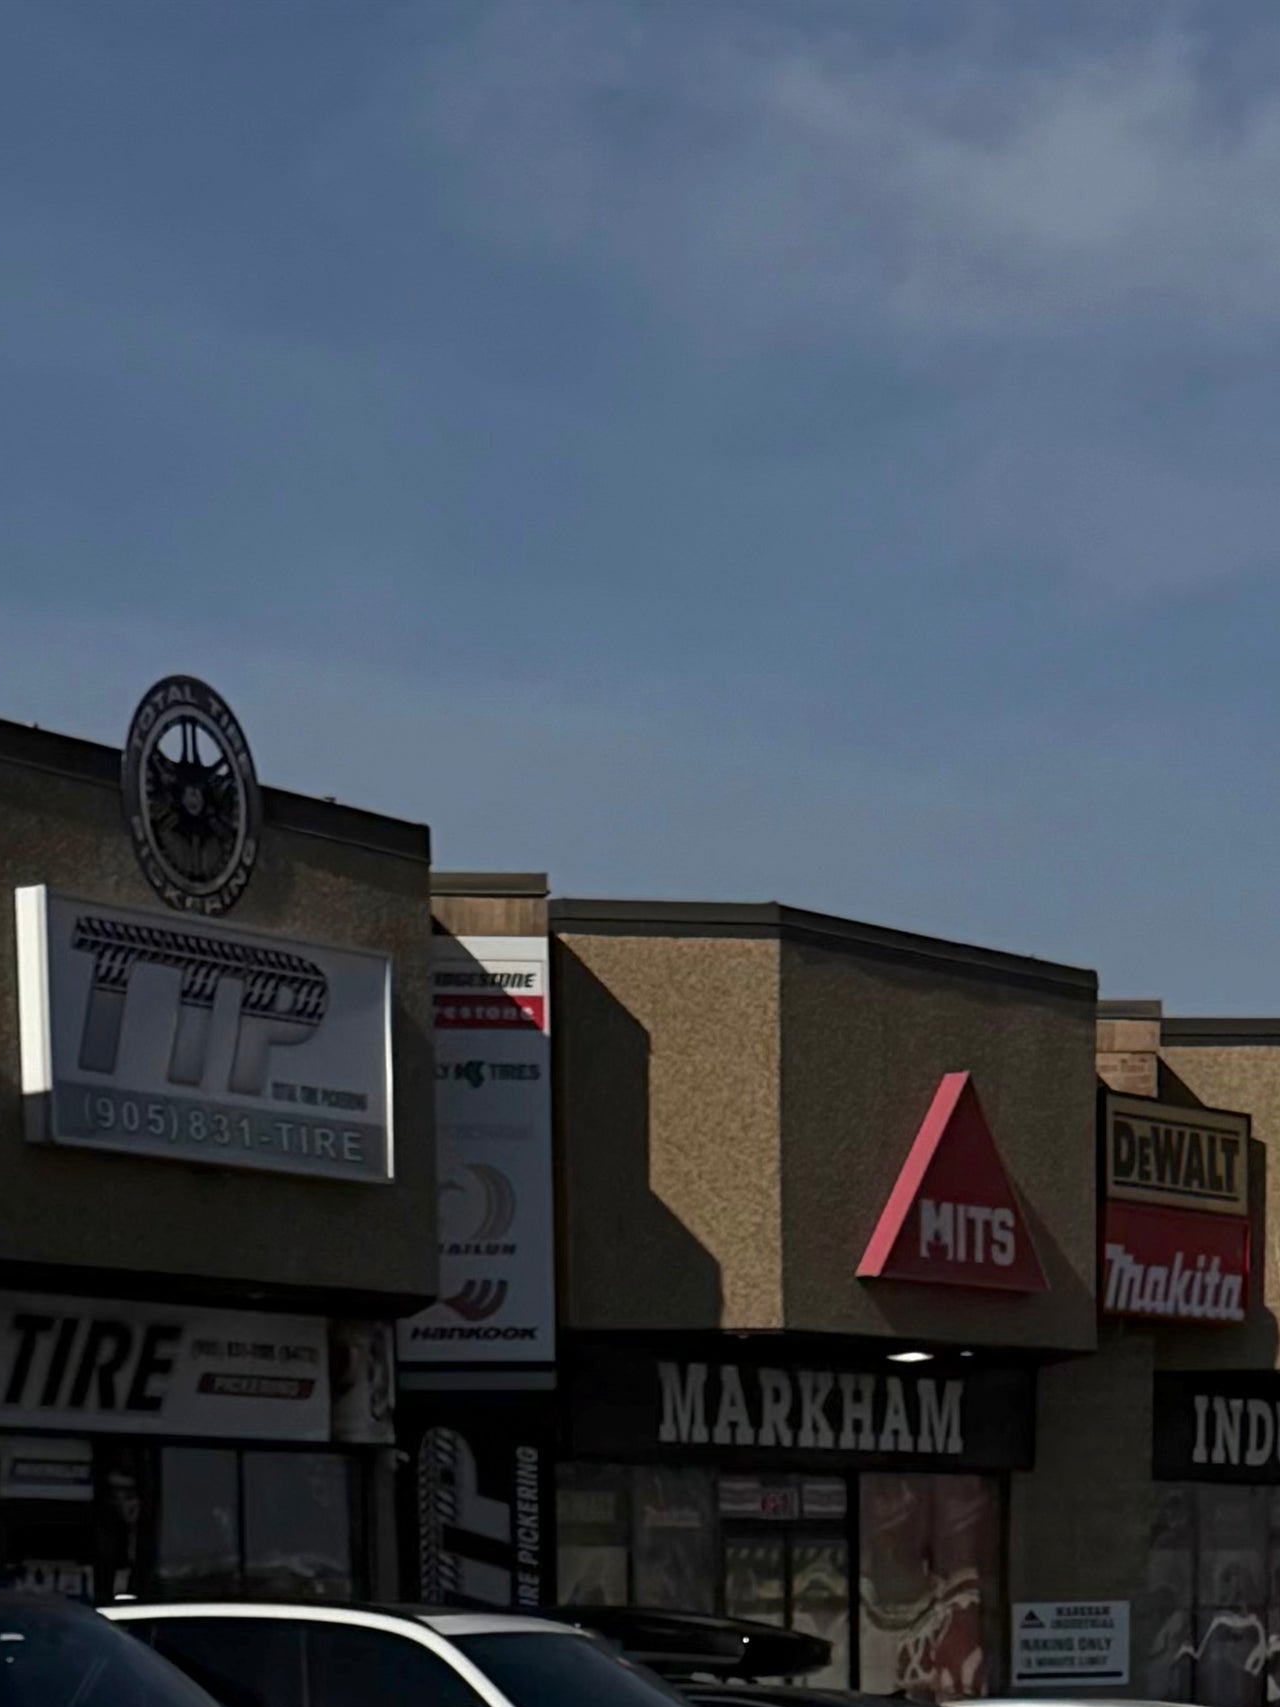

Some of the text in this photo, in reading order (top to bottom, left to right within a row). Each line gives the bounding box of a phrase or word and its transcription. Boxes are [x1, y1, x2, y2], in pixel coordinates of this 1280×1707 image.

[920, 1199, 1016, 1267] MITS
[5, 1314, 183, 1411] TIRE
[657, 1362, 965, 1454] MARKHAM
[515, 1445, 540, 1566] PICKERING
